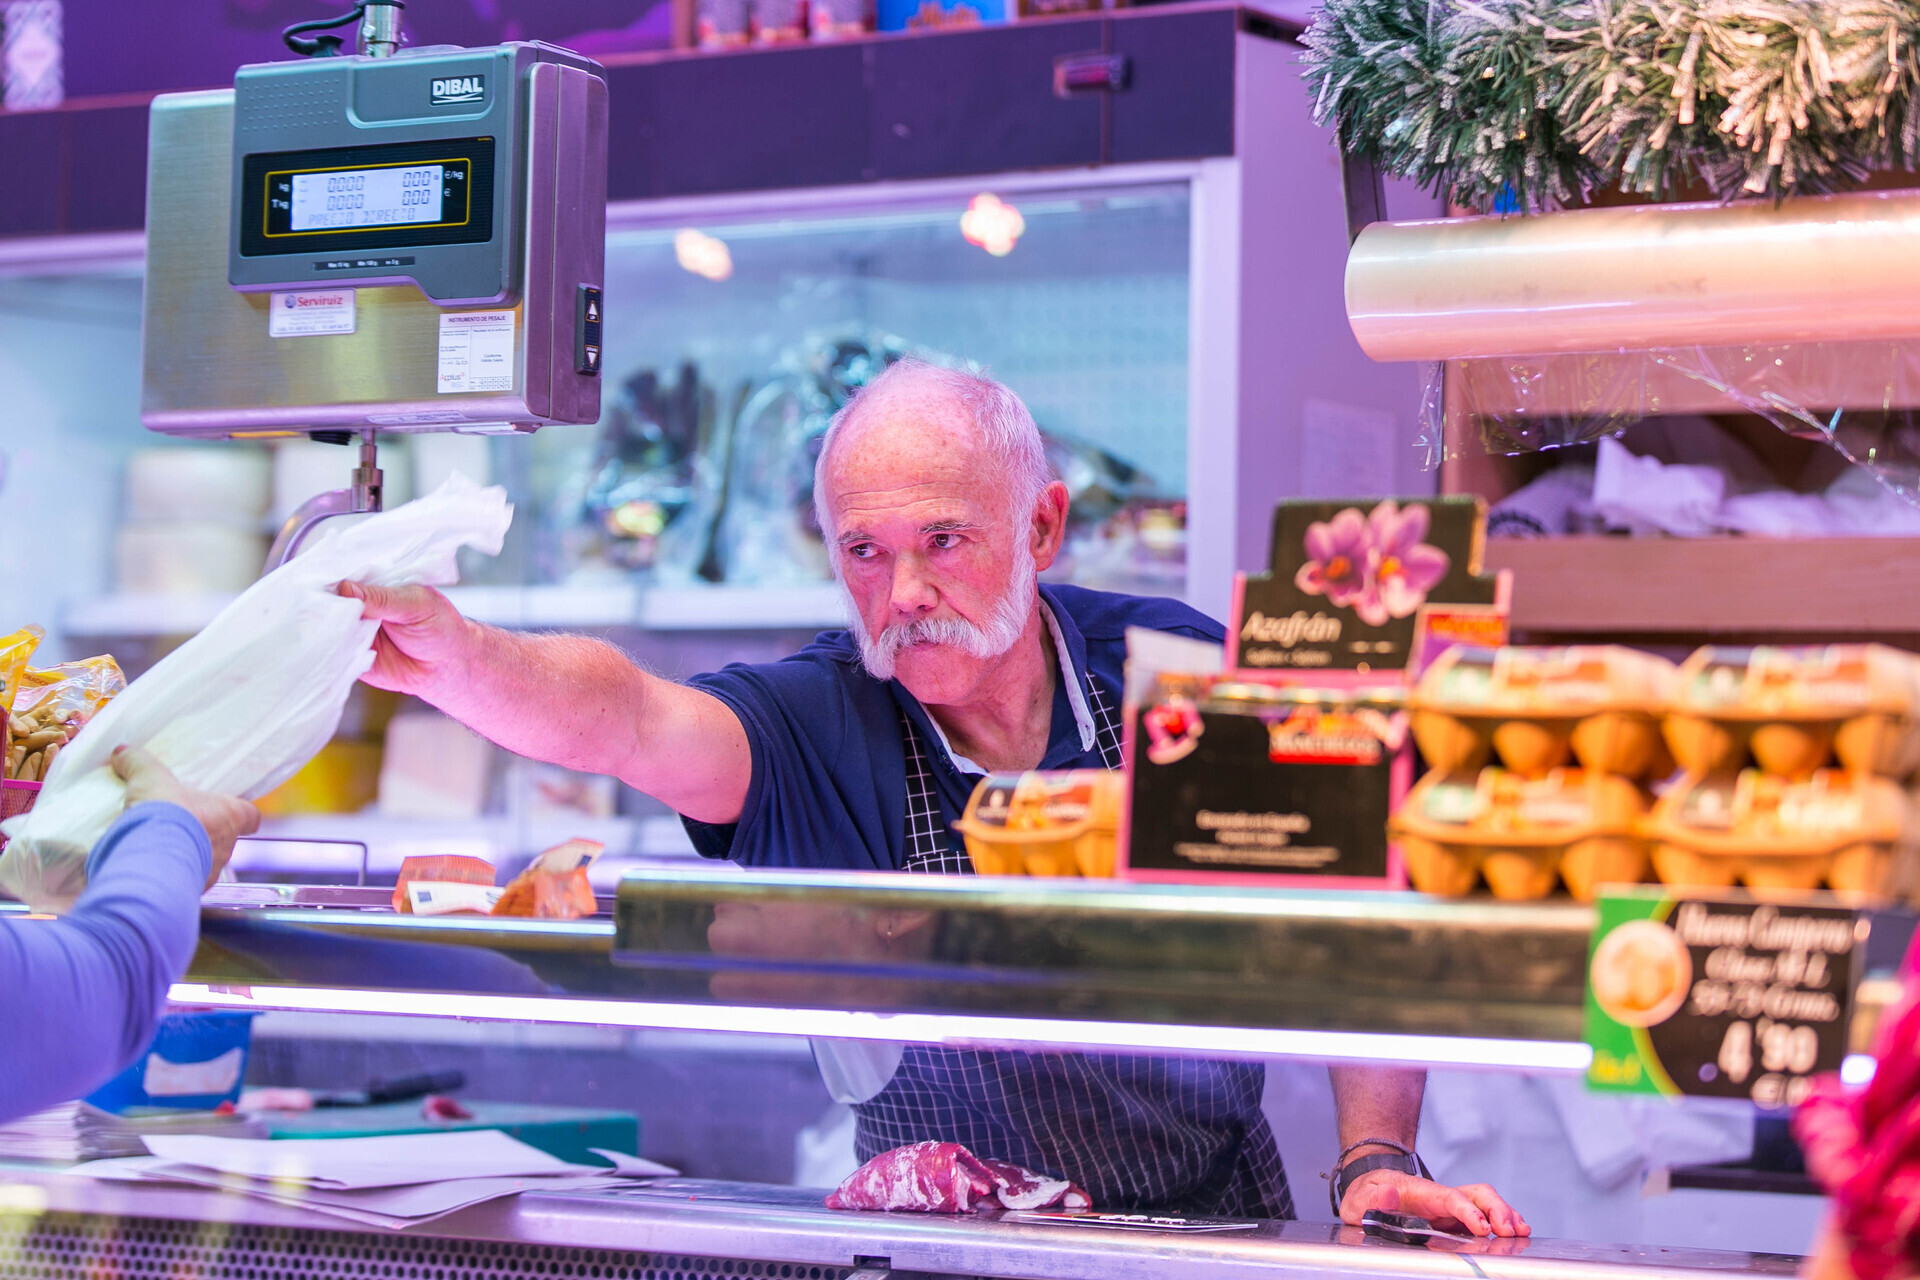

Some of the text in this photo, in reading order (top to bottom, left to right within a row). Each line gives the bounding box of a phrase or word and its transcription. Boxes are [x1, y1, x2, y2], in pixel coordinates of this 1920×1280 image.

[432, 77, 483, 96] DIBAL
[297, 295, 343, 307] Serviruiz
[488, 314, 506, 322] PESAJE
